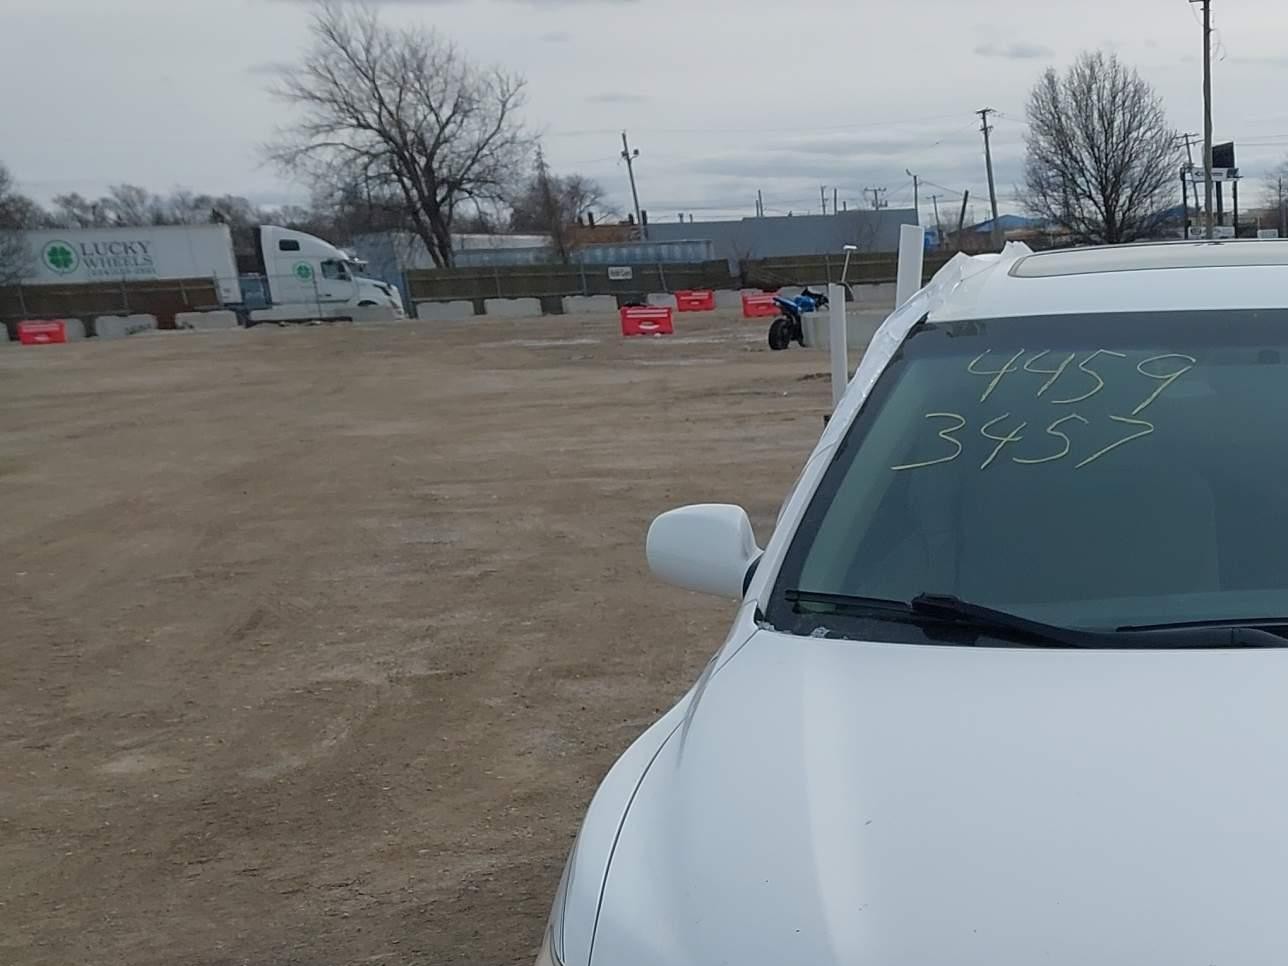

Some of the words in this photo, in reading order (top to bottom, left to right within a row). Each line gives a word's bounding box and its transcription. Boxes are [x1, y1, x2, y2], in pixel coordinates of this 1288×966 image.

[80, 241, 150, 256] LUCKY
[83, 256, 153, 269] WHEELS
[967, 347, 1197, 416] 4459
[889, 411, 1155, 471] 3457
